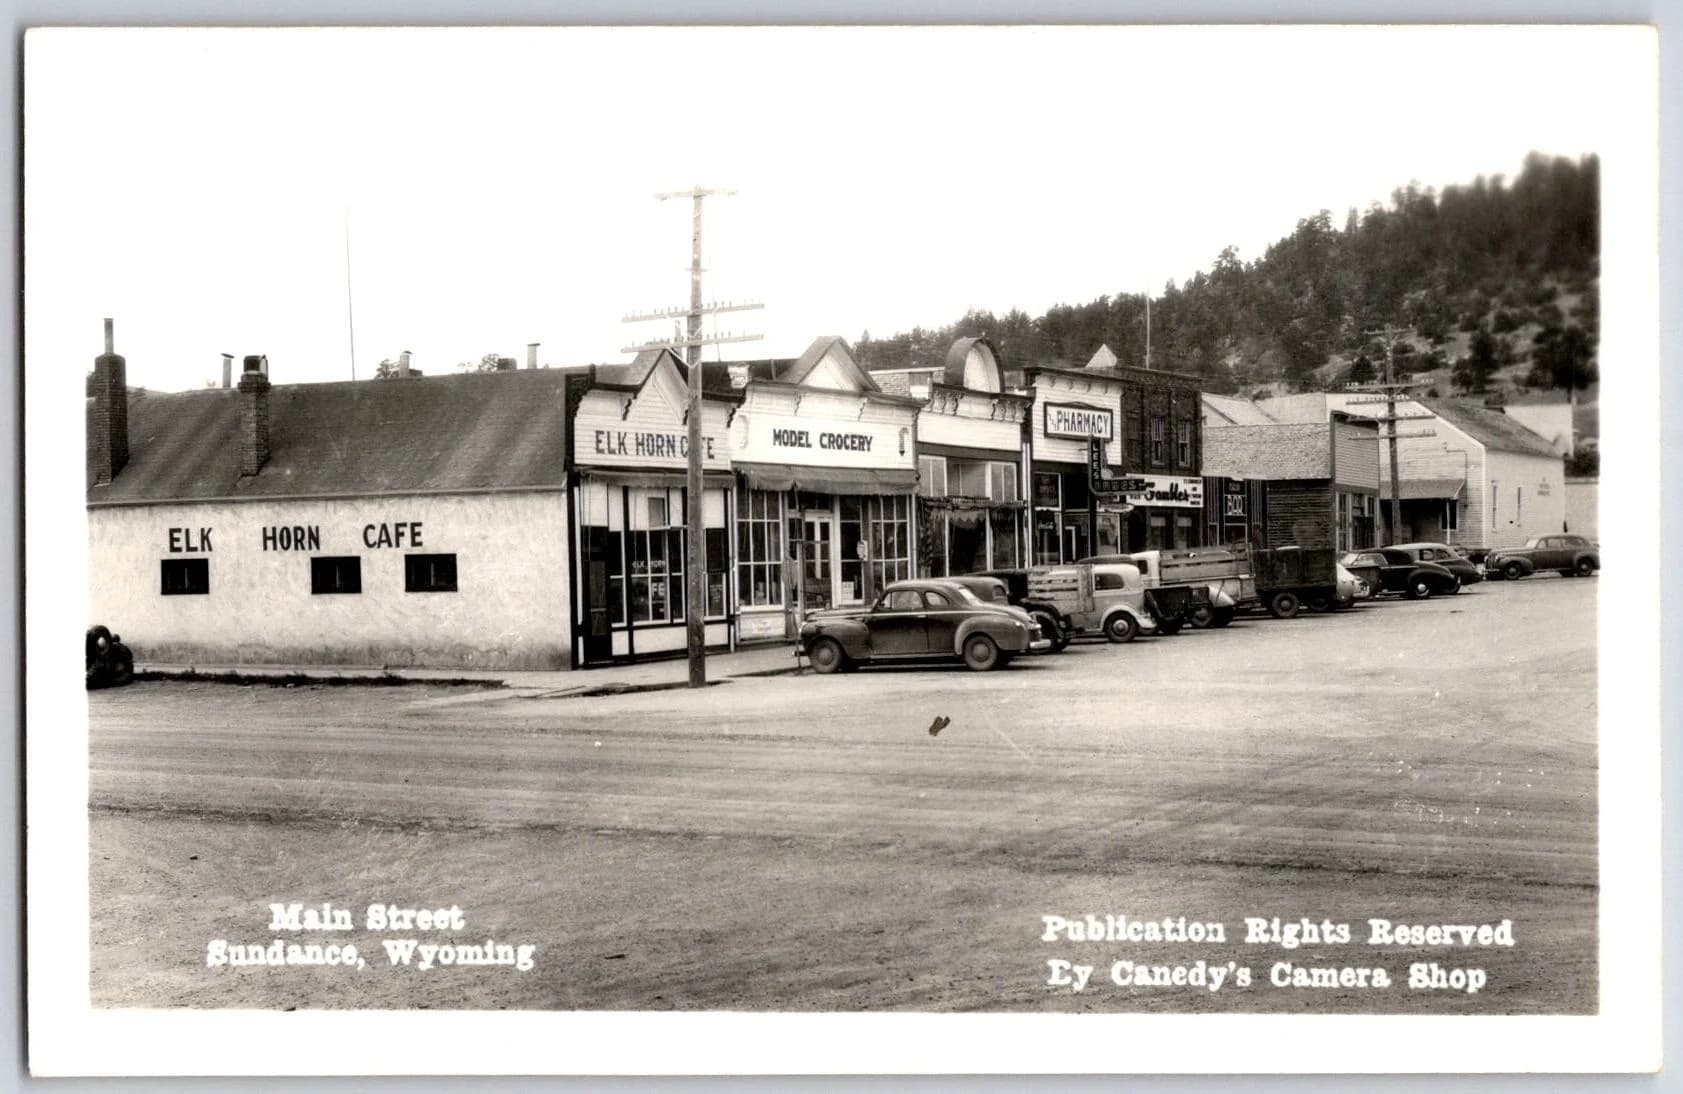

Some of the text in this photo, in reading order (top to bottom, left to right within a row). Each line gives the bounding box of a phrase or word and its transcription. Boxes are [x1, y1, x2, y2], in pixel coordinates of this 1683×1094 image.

[1056, 410, 1109, 435] PHARMACY
[595, 430, 714, 459] ELK HORN CE
[772, 428, 812, 448] MODEL
[168, 522, 424, 553] ELK HORN CAFE
